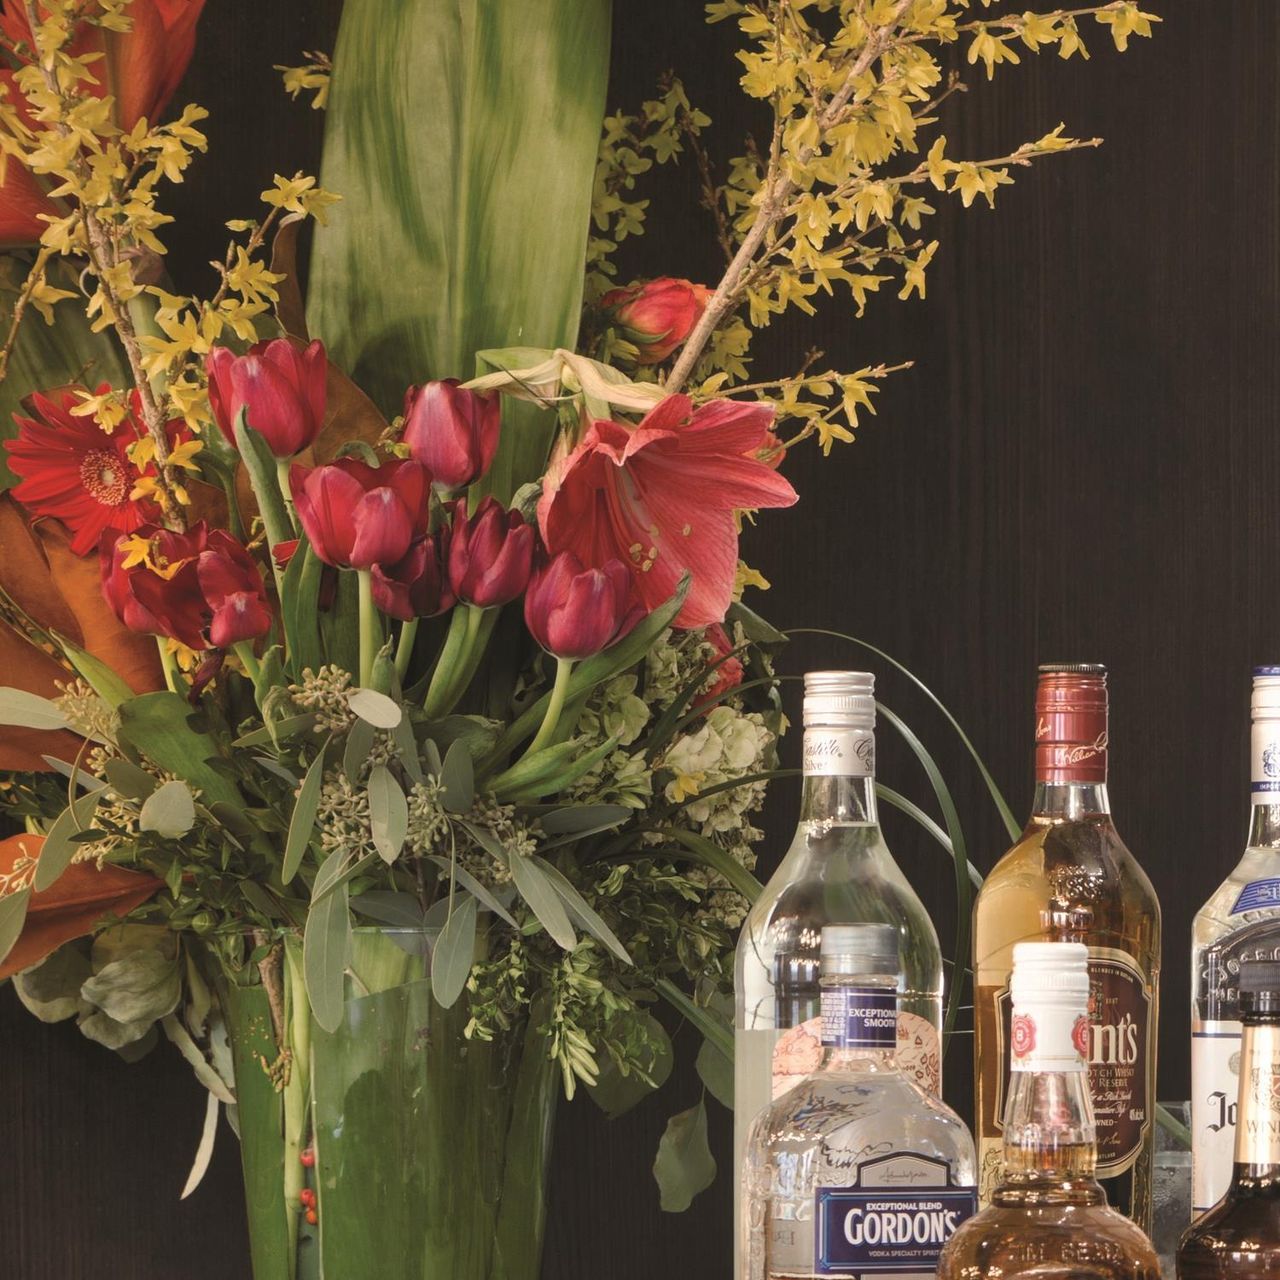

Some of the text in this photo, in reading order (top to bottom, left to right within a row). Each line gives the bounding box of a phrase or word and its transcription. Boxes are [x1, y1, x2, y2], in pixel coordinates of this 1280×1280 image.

[866, 1202, 943, 1211] EXCEPTIONAL BLEND
[844, 1209, 958, 1246] GORDON'S
[868, 1250, 890, 1258] VODKA
[891, 1249, 922, 1258] SPECIALTY
